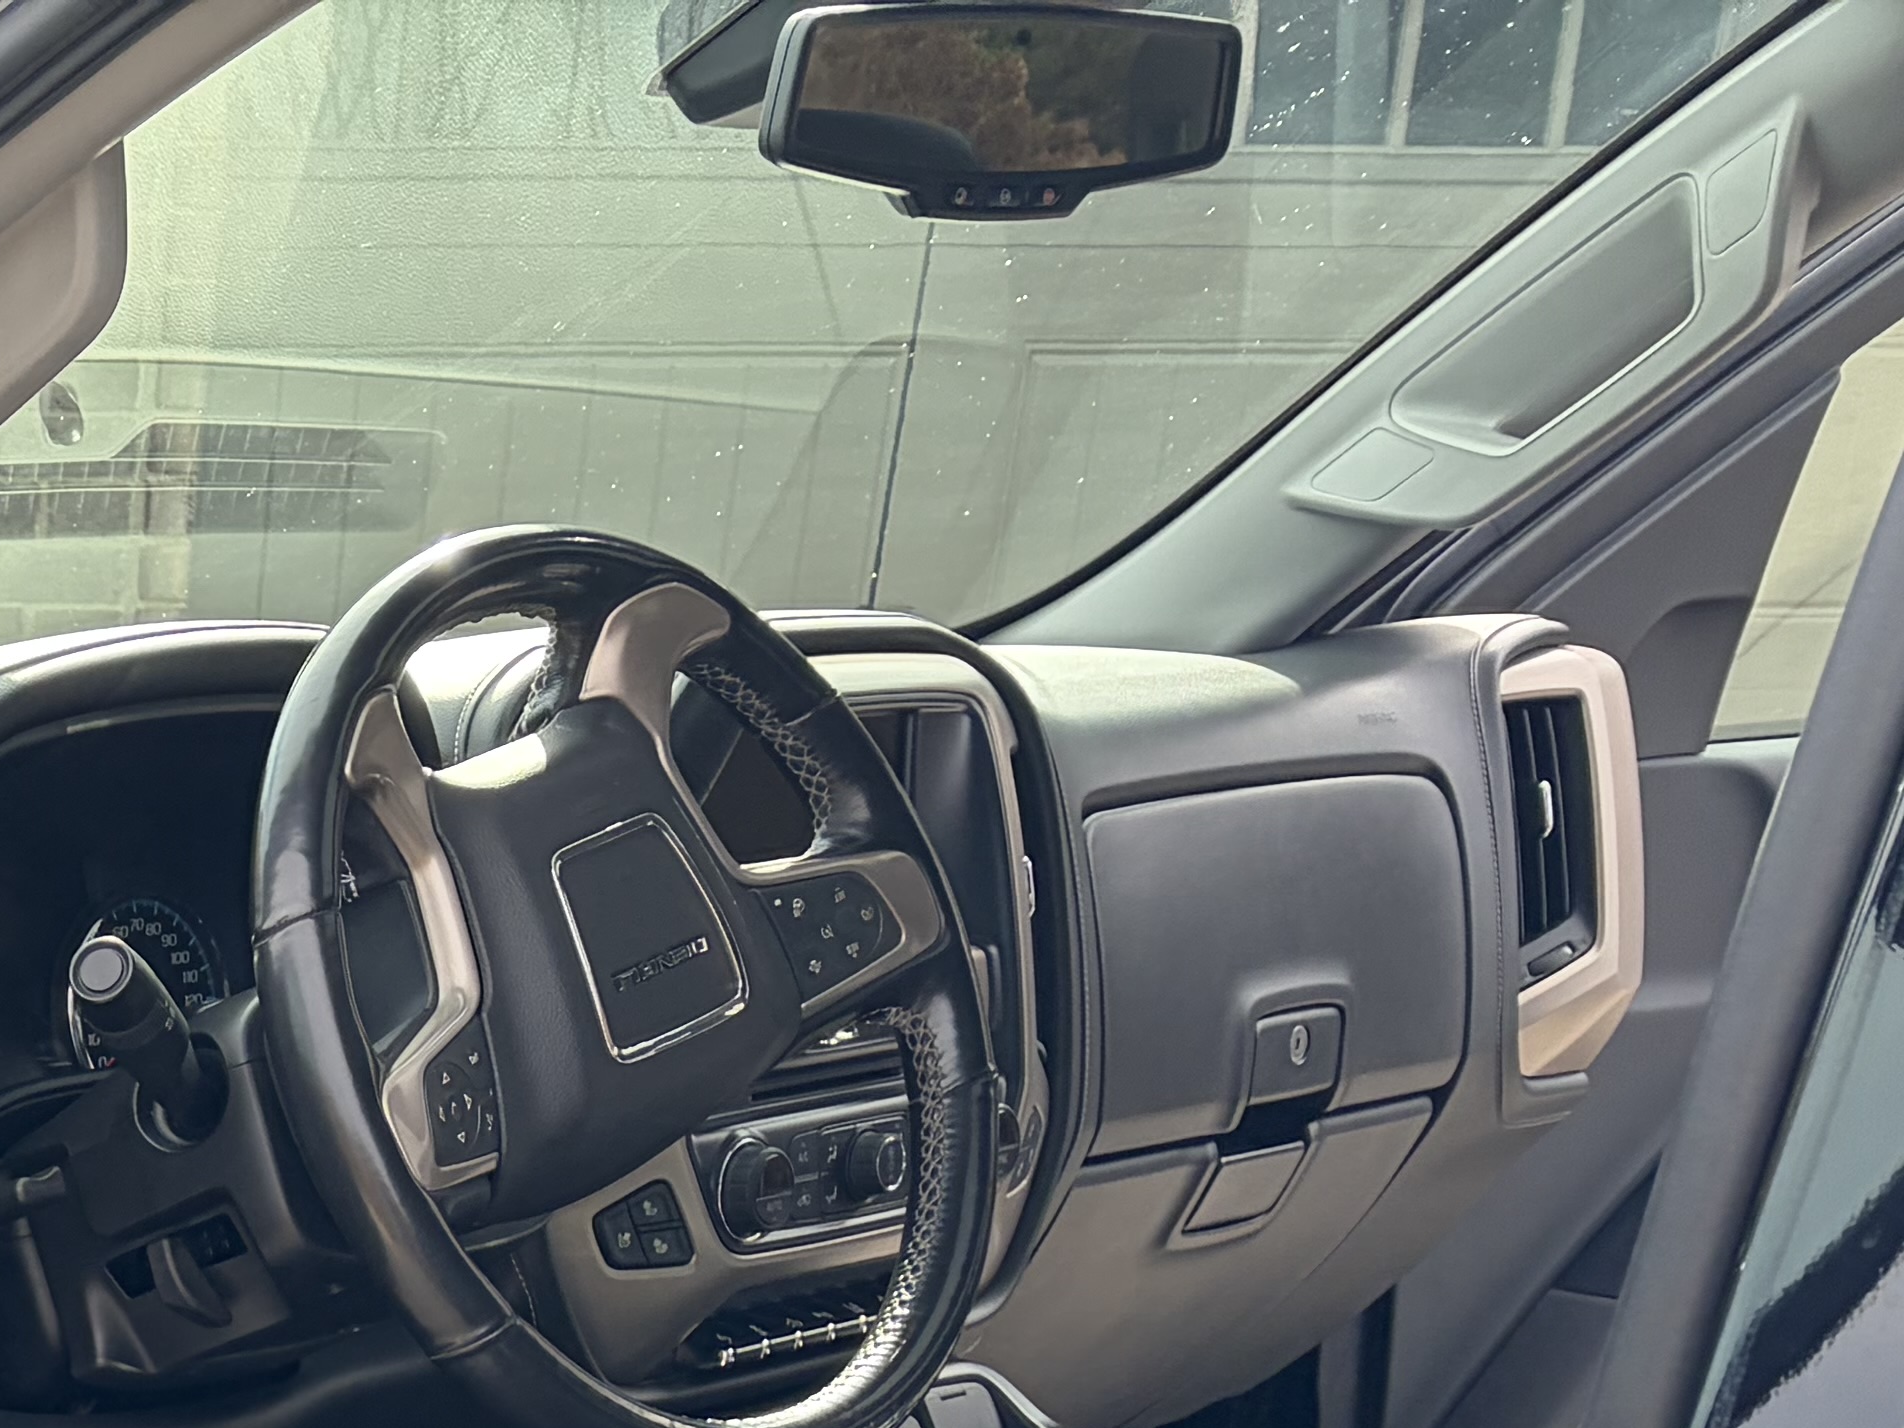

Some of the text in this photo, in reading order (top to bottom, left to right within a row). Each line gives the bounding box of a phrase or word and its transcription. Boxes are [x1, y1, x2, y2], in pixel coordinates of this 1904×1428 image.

[130, 918, 145, 932] 70
[145, 922, 162, 936] 80
[160, 933, 178, 948] 90
[170, 950, 190, 965] 100
[182, 969, 199, 984] 110
